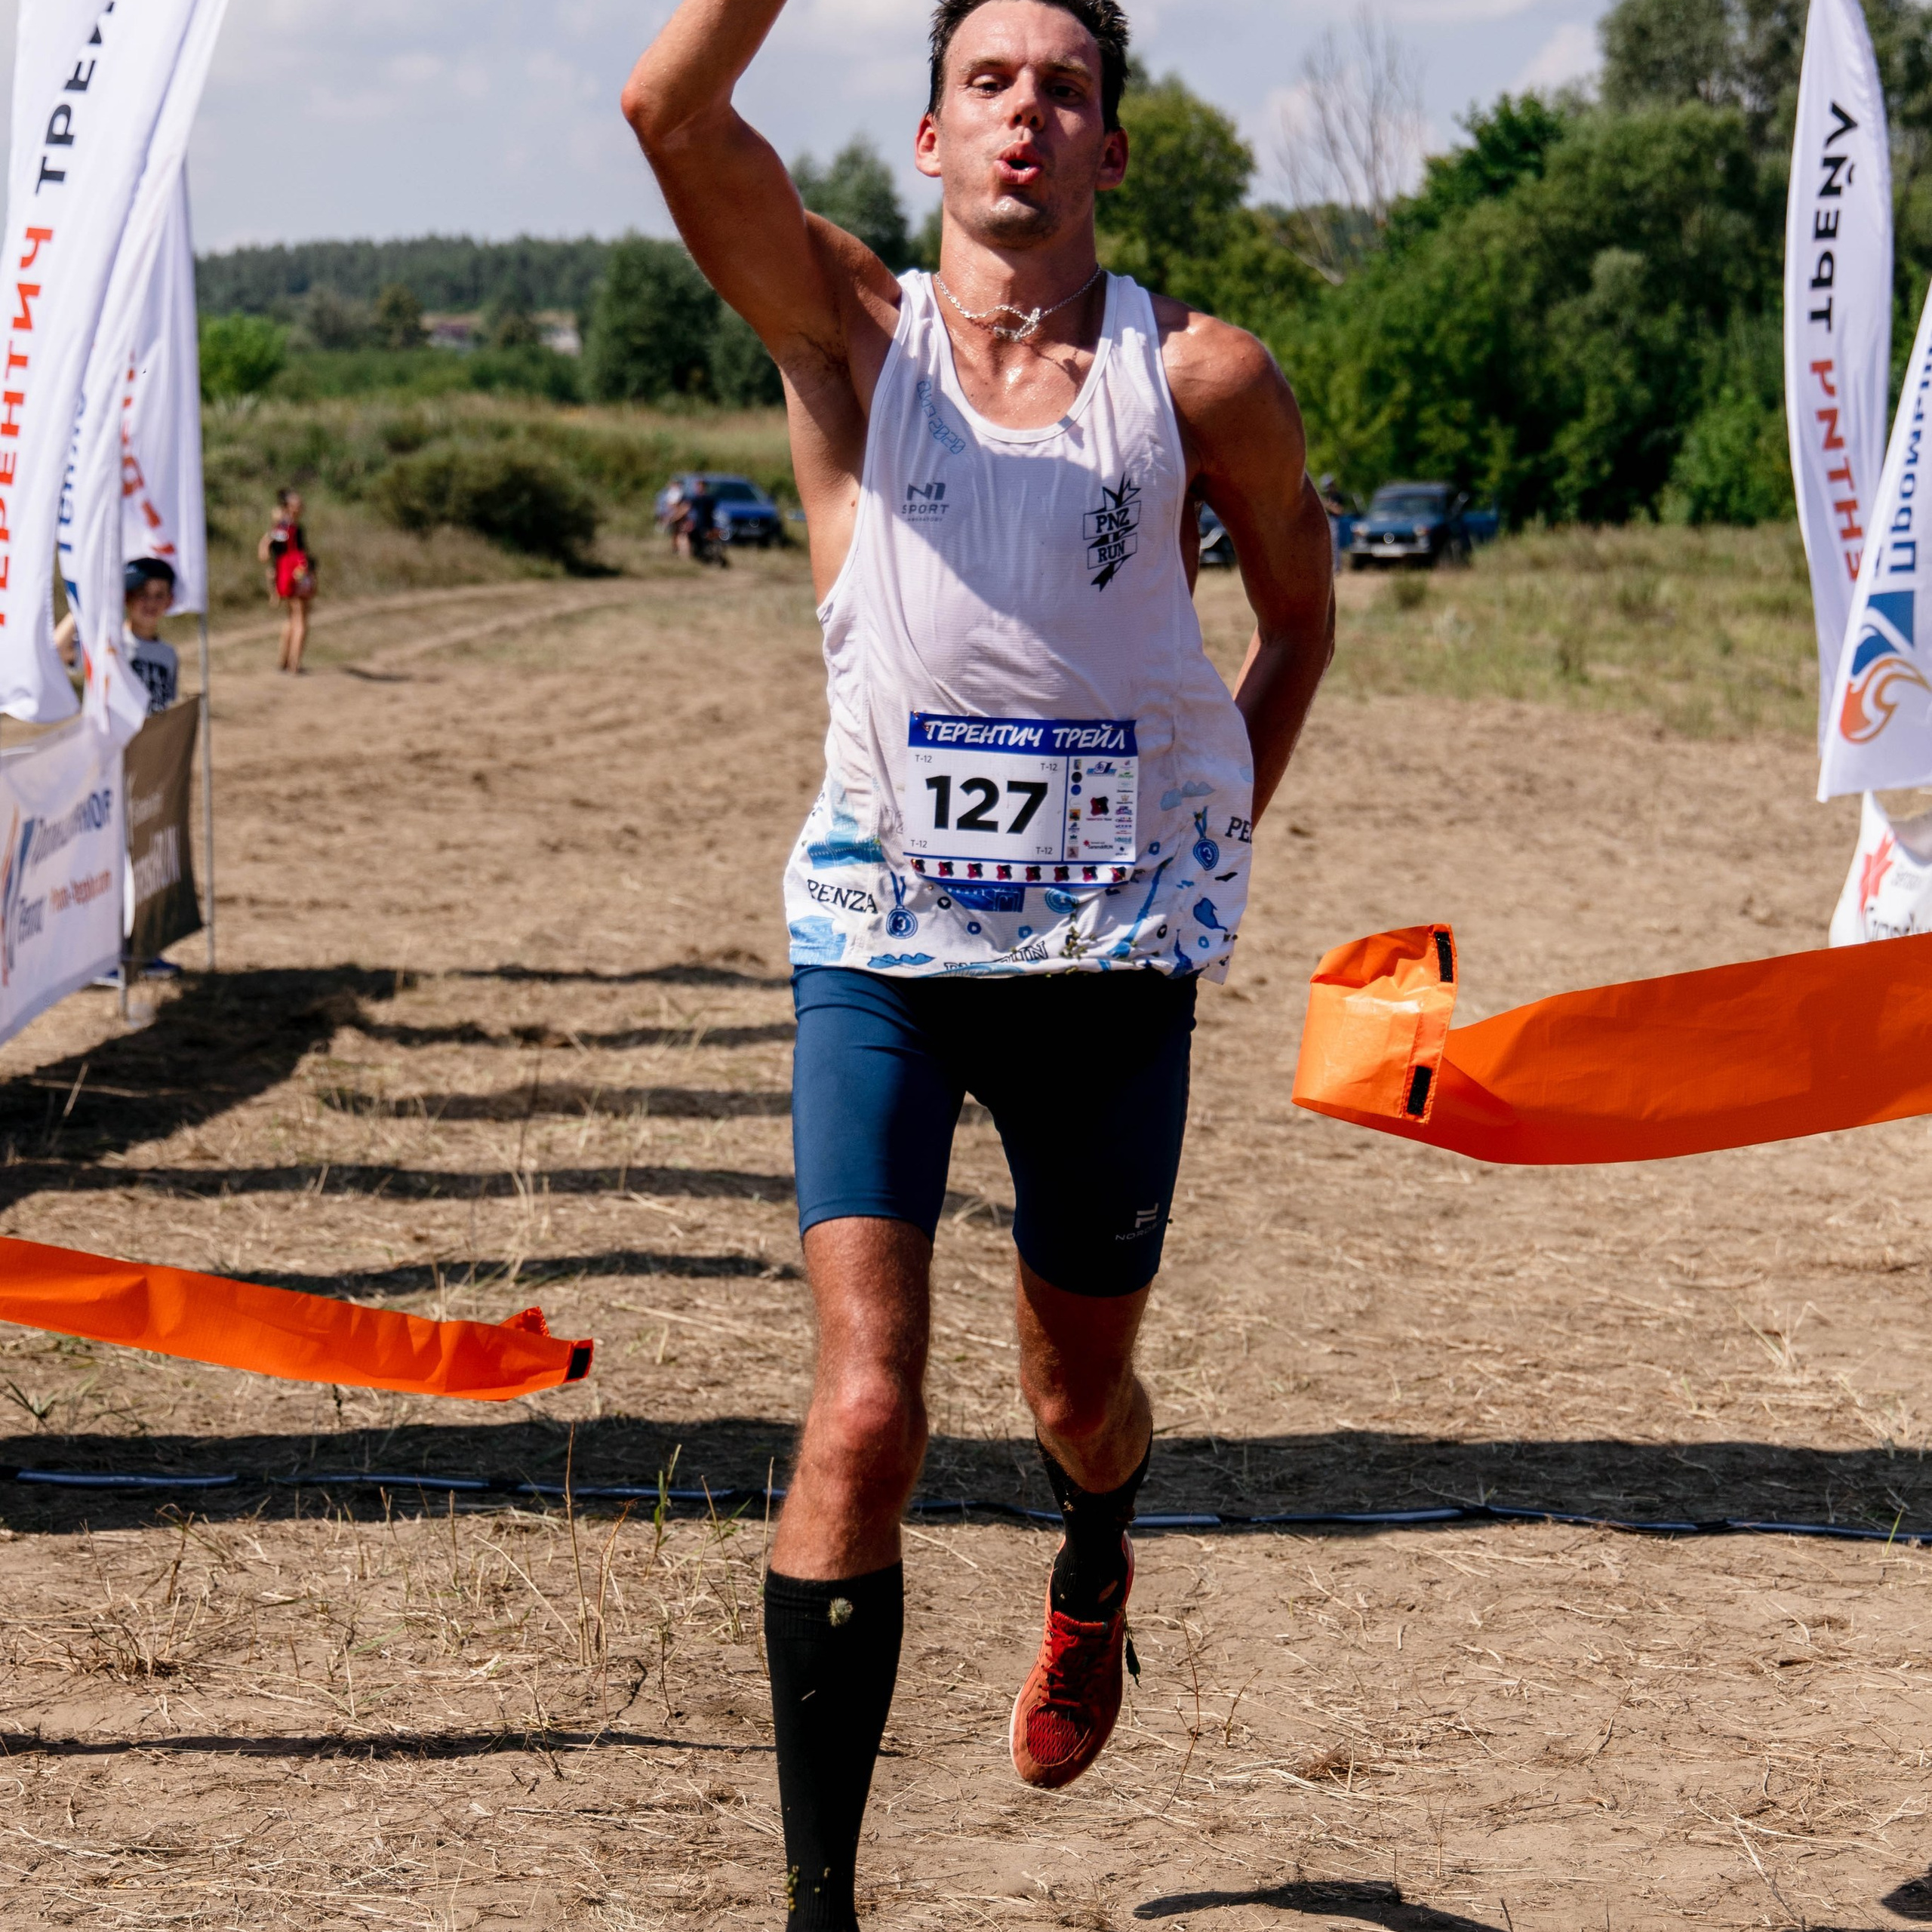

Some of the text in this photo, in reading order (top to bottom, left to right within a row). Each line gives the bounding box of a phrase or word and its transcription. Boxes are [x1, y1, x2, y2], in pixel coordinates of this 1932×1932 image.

[0, 226, 54, 626] ЕНТИЧ
[901, 503, 950, 515] SPORT
[1096, 507, 1130, 534] PNZ
[1097, 540, 1125, 563] RUN
[924, 720, 1125, 749] ТЕРЕНТИЧ ТРЕЙЛ
[925, 775, 1048, 835] 127
[807, 878, 878, 914] PENZA
